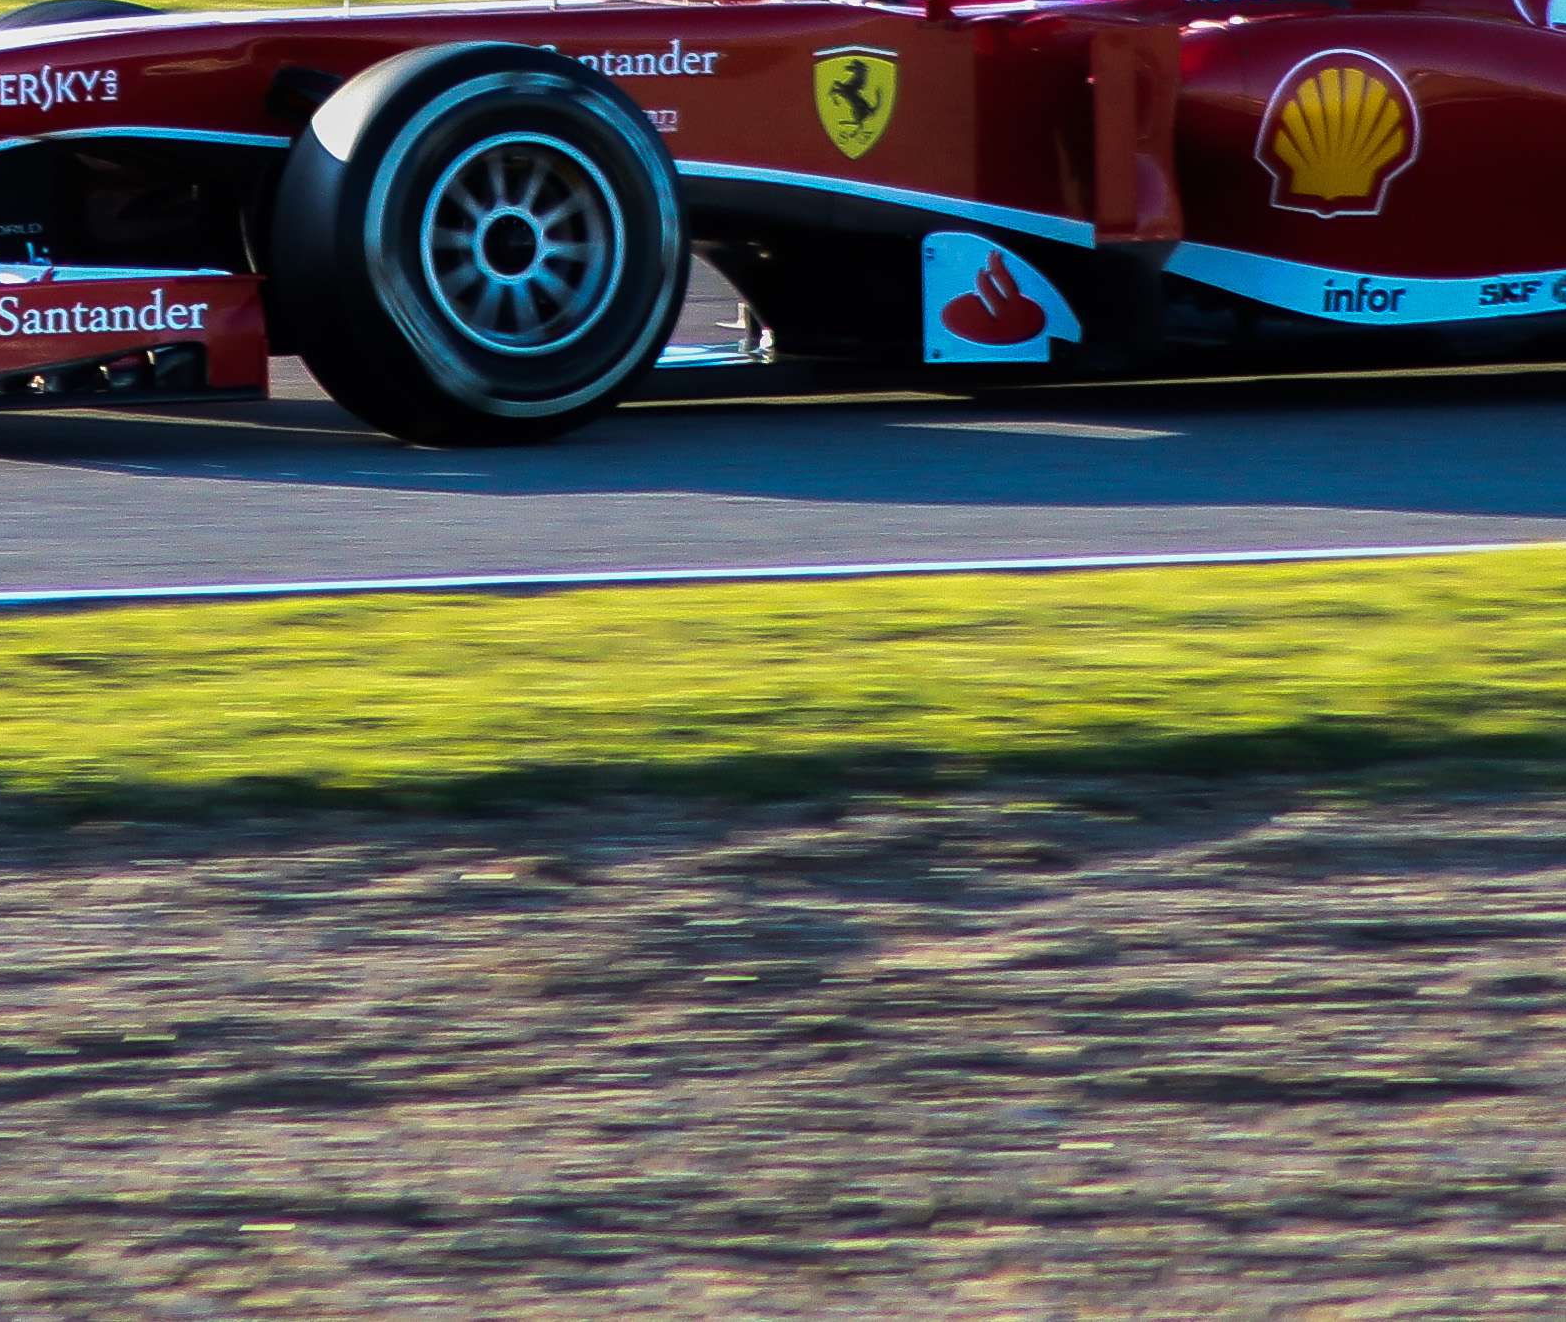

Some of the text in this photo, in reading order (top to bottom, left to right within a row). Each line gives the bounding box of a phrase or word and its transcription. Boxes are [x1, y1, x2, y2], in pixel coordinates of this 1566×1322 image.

[538, 39, 719, 76] ntander
[1322, 278, 1406, 313] infor
[1478, 280, 1545, 306] SKF
